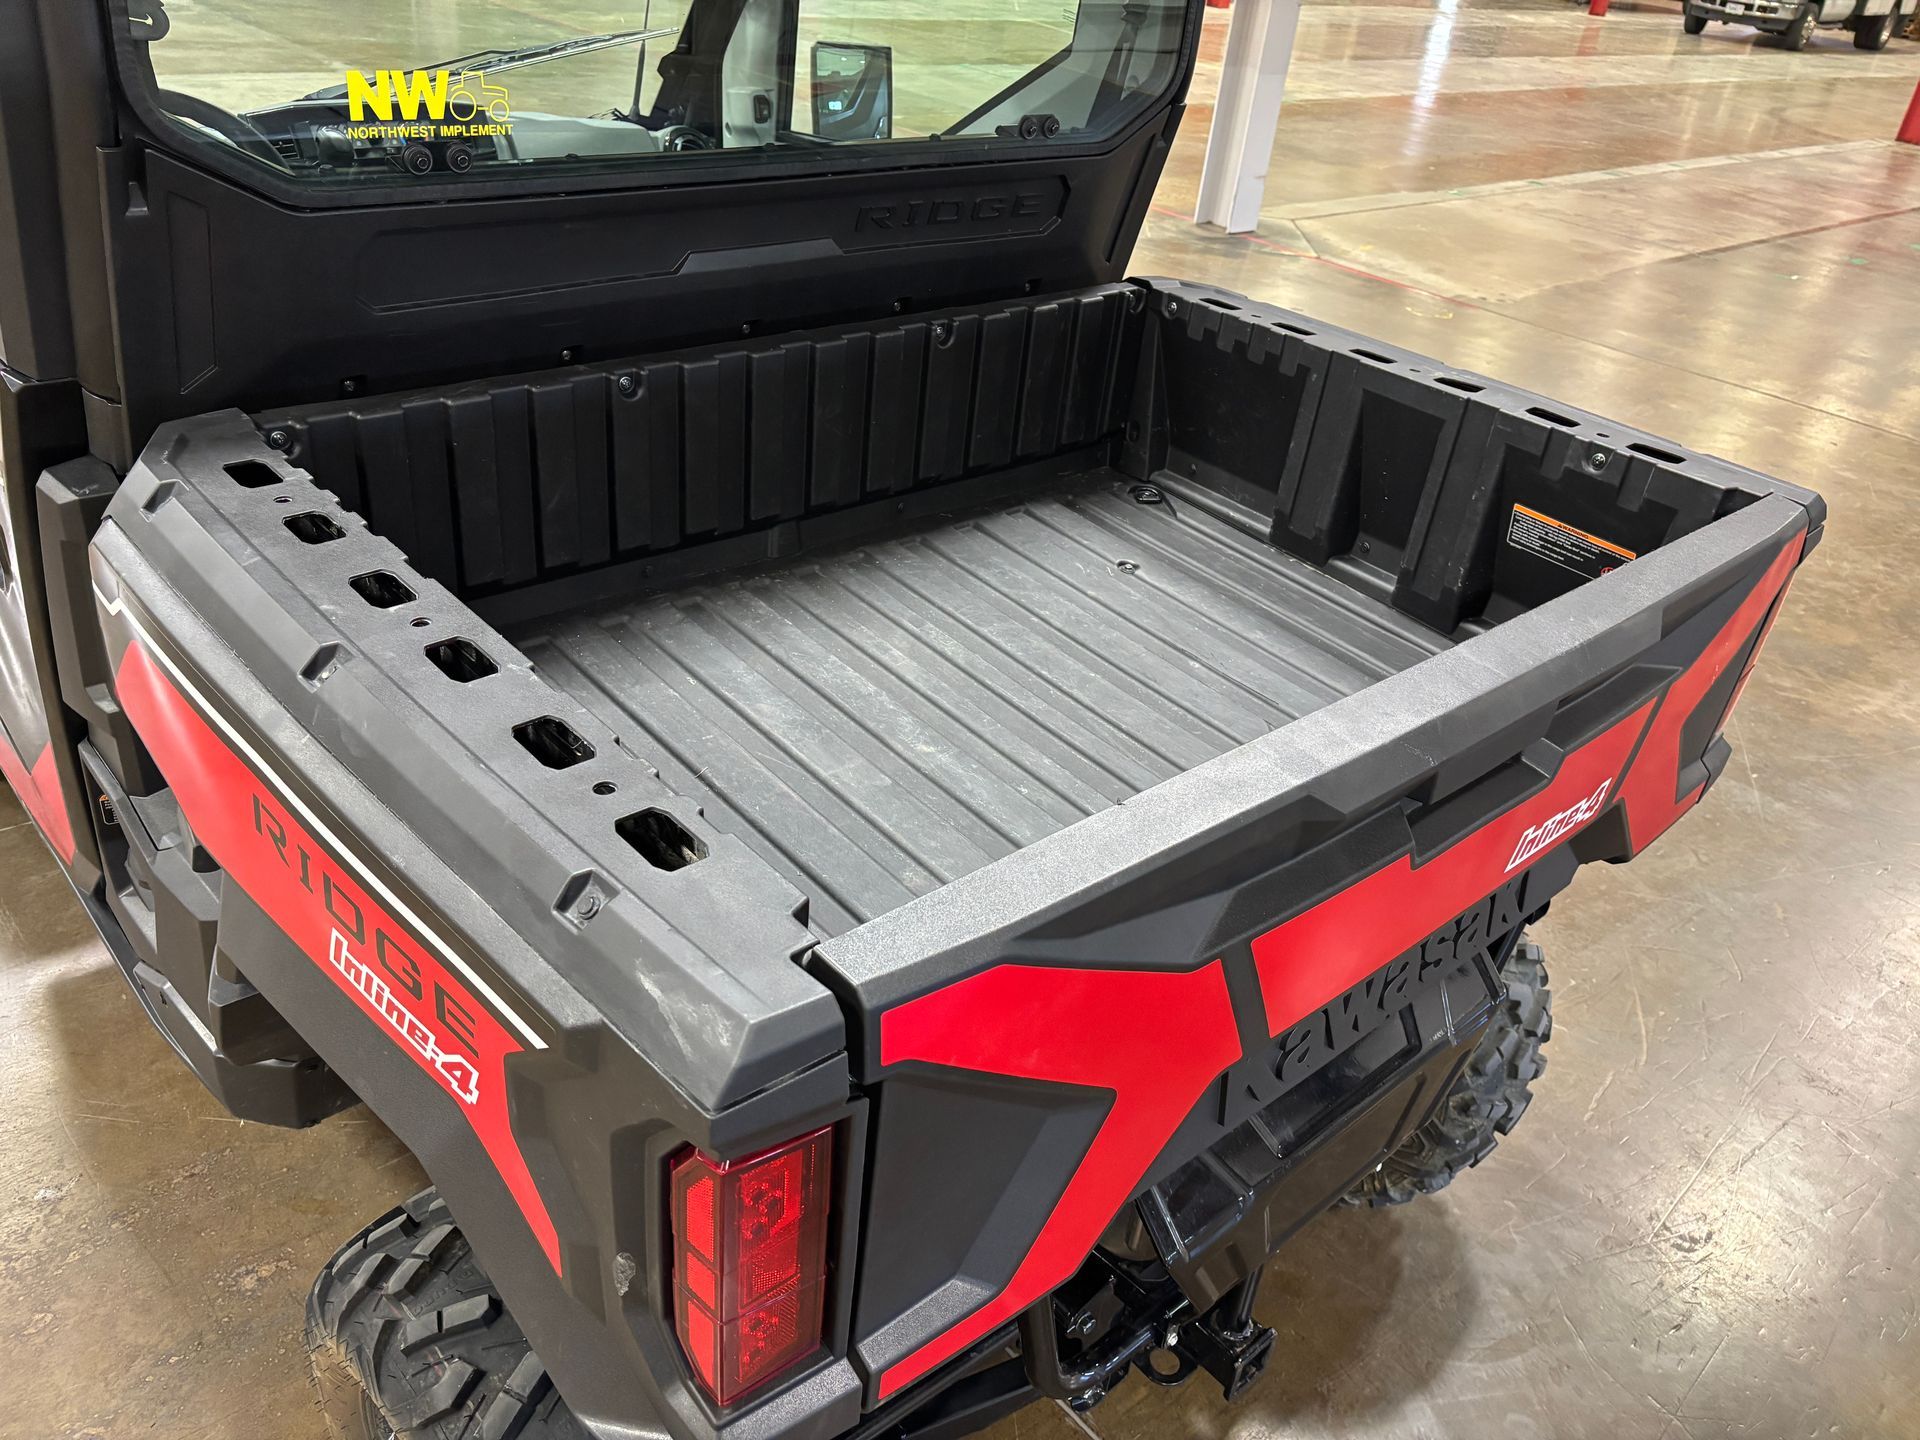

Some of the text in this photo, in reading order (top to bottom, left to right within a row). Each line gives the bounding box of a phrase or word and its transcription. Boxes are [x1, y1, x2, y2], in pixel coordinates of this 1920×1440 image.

[346, 70, 450, 121] NW
[347, 125, 514, 139] NORTHWEST IMPLEMENT
[854, 193, 1046, 233] RIDGE
[1503, 777, 1612, 874] Inline-4
[252, 793, 479, 1057] RIDGE
[329, 927, 480, 1105] Inline-4
[1217, 868, 1542, 1128] Kawasaki
